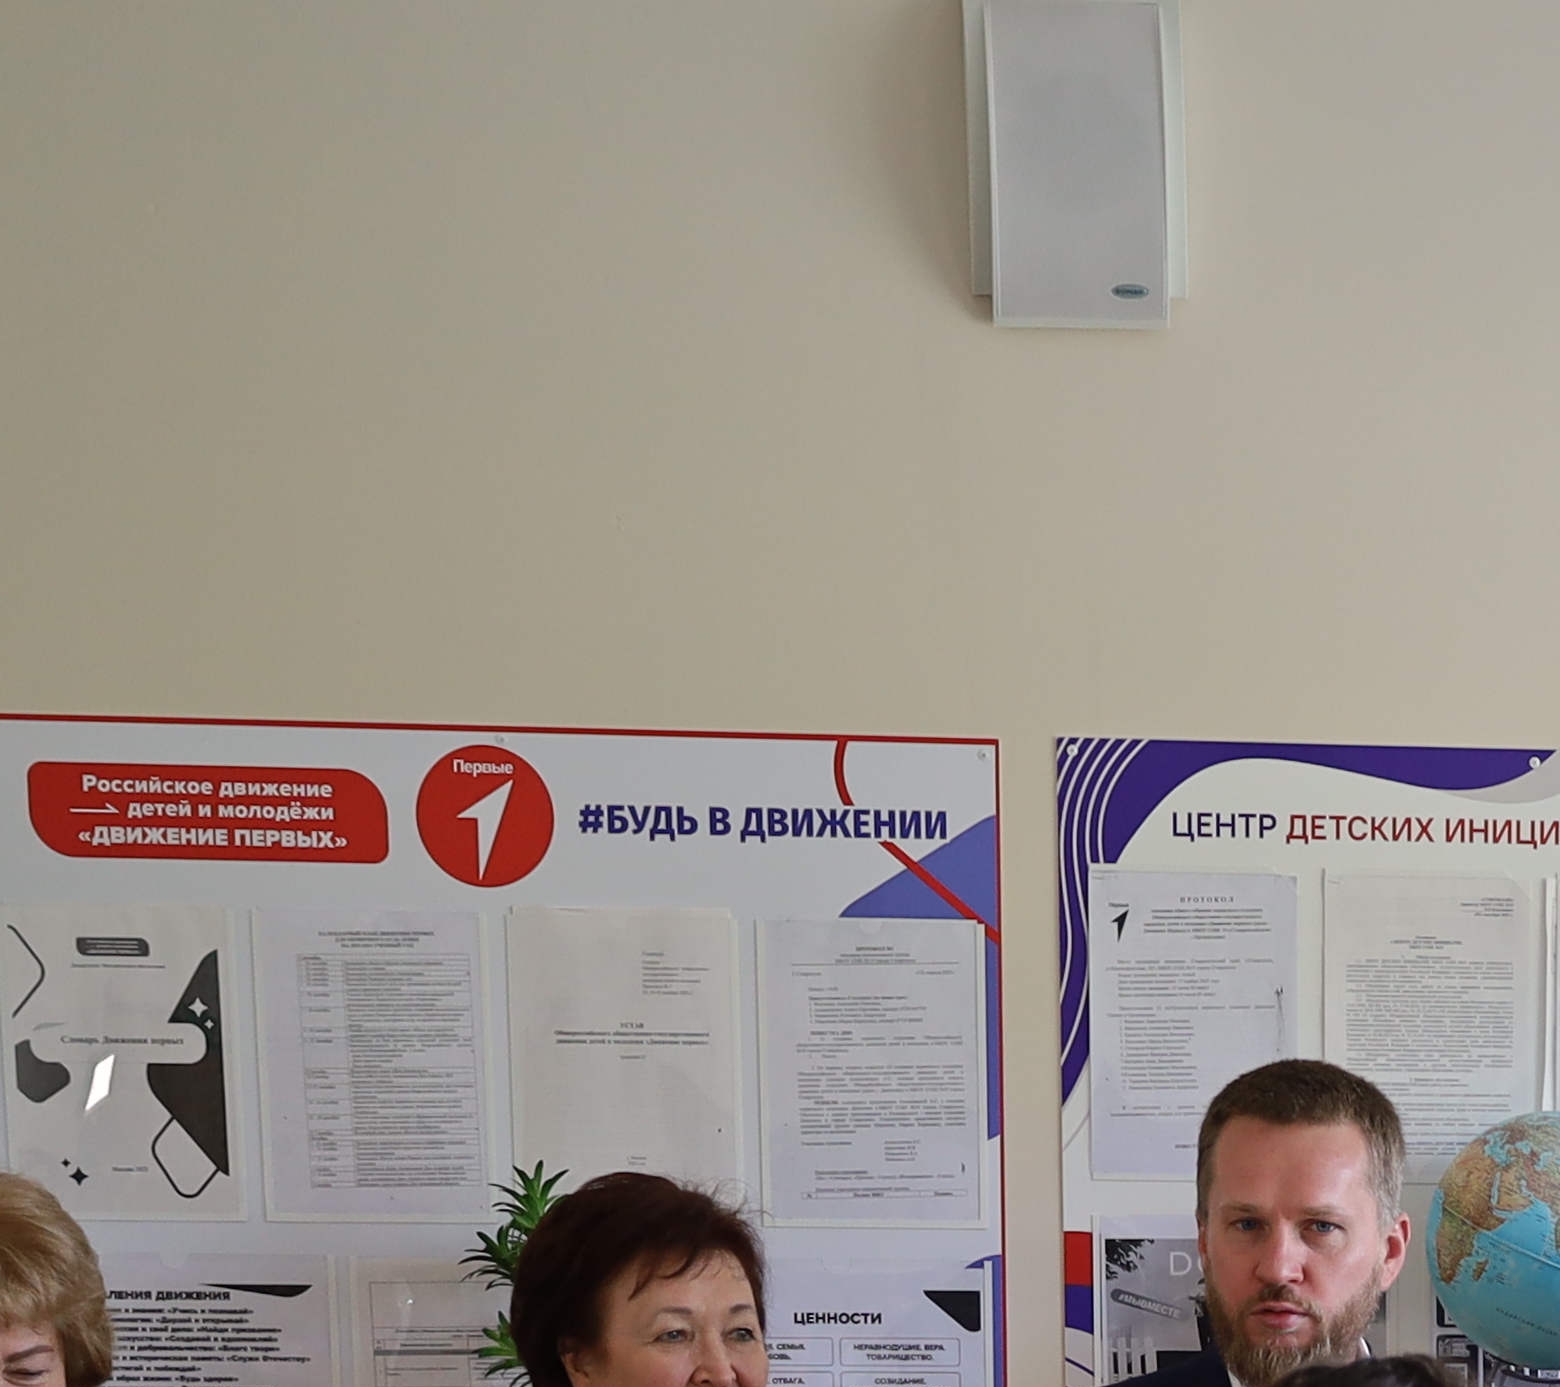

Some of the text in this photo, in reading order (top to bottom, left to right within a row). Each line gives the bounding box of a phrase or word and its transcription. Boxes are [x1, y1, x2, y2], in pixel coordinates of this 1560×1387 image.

[452, 758, 514, 778] Первые
[82, 774, 333, 799] Российское движение
[127, 799, 334, 822] детей и молодёжи
[578, 803, 948, 843] #БУДЬ В ДВИЖЕНИИ
[1171, 812, 1277, 842] ЦЕНТР
[1285, 814, 1435, 844] ДЕТСКИХ
[78, 825, 349, 849] «ДВИЖЕНИЕ ПЕРВЫХ»
[107, 1290, 231, 1301] ЛЕНИЯ ДВИЖЕНИЯ
[1118, 1292, 1182, 1318] #МЫВМЕСТЕ
[794, 1312, 882, 1325] ЦЕННОСТИ
